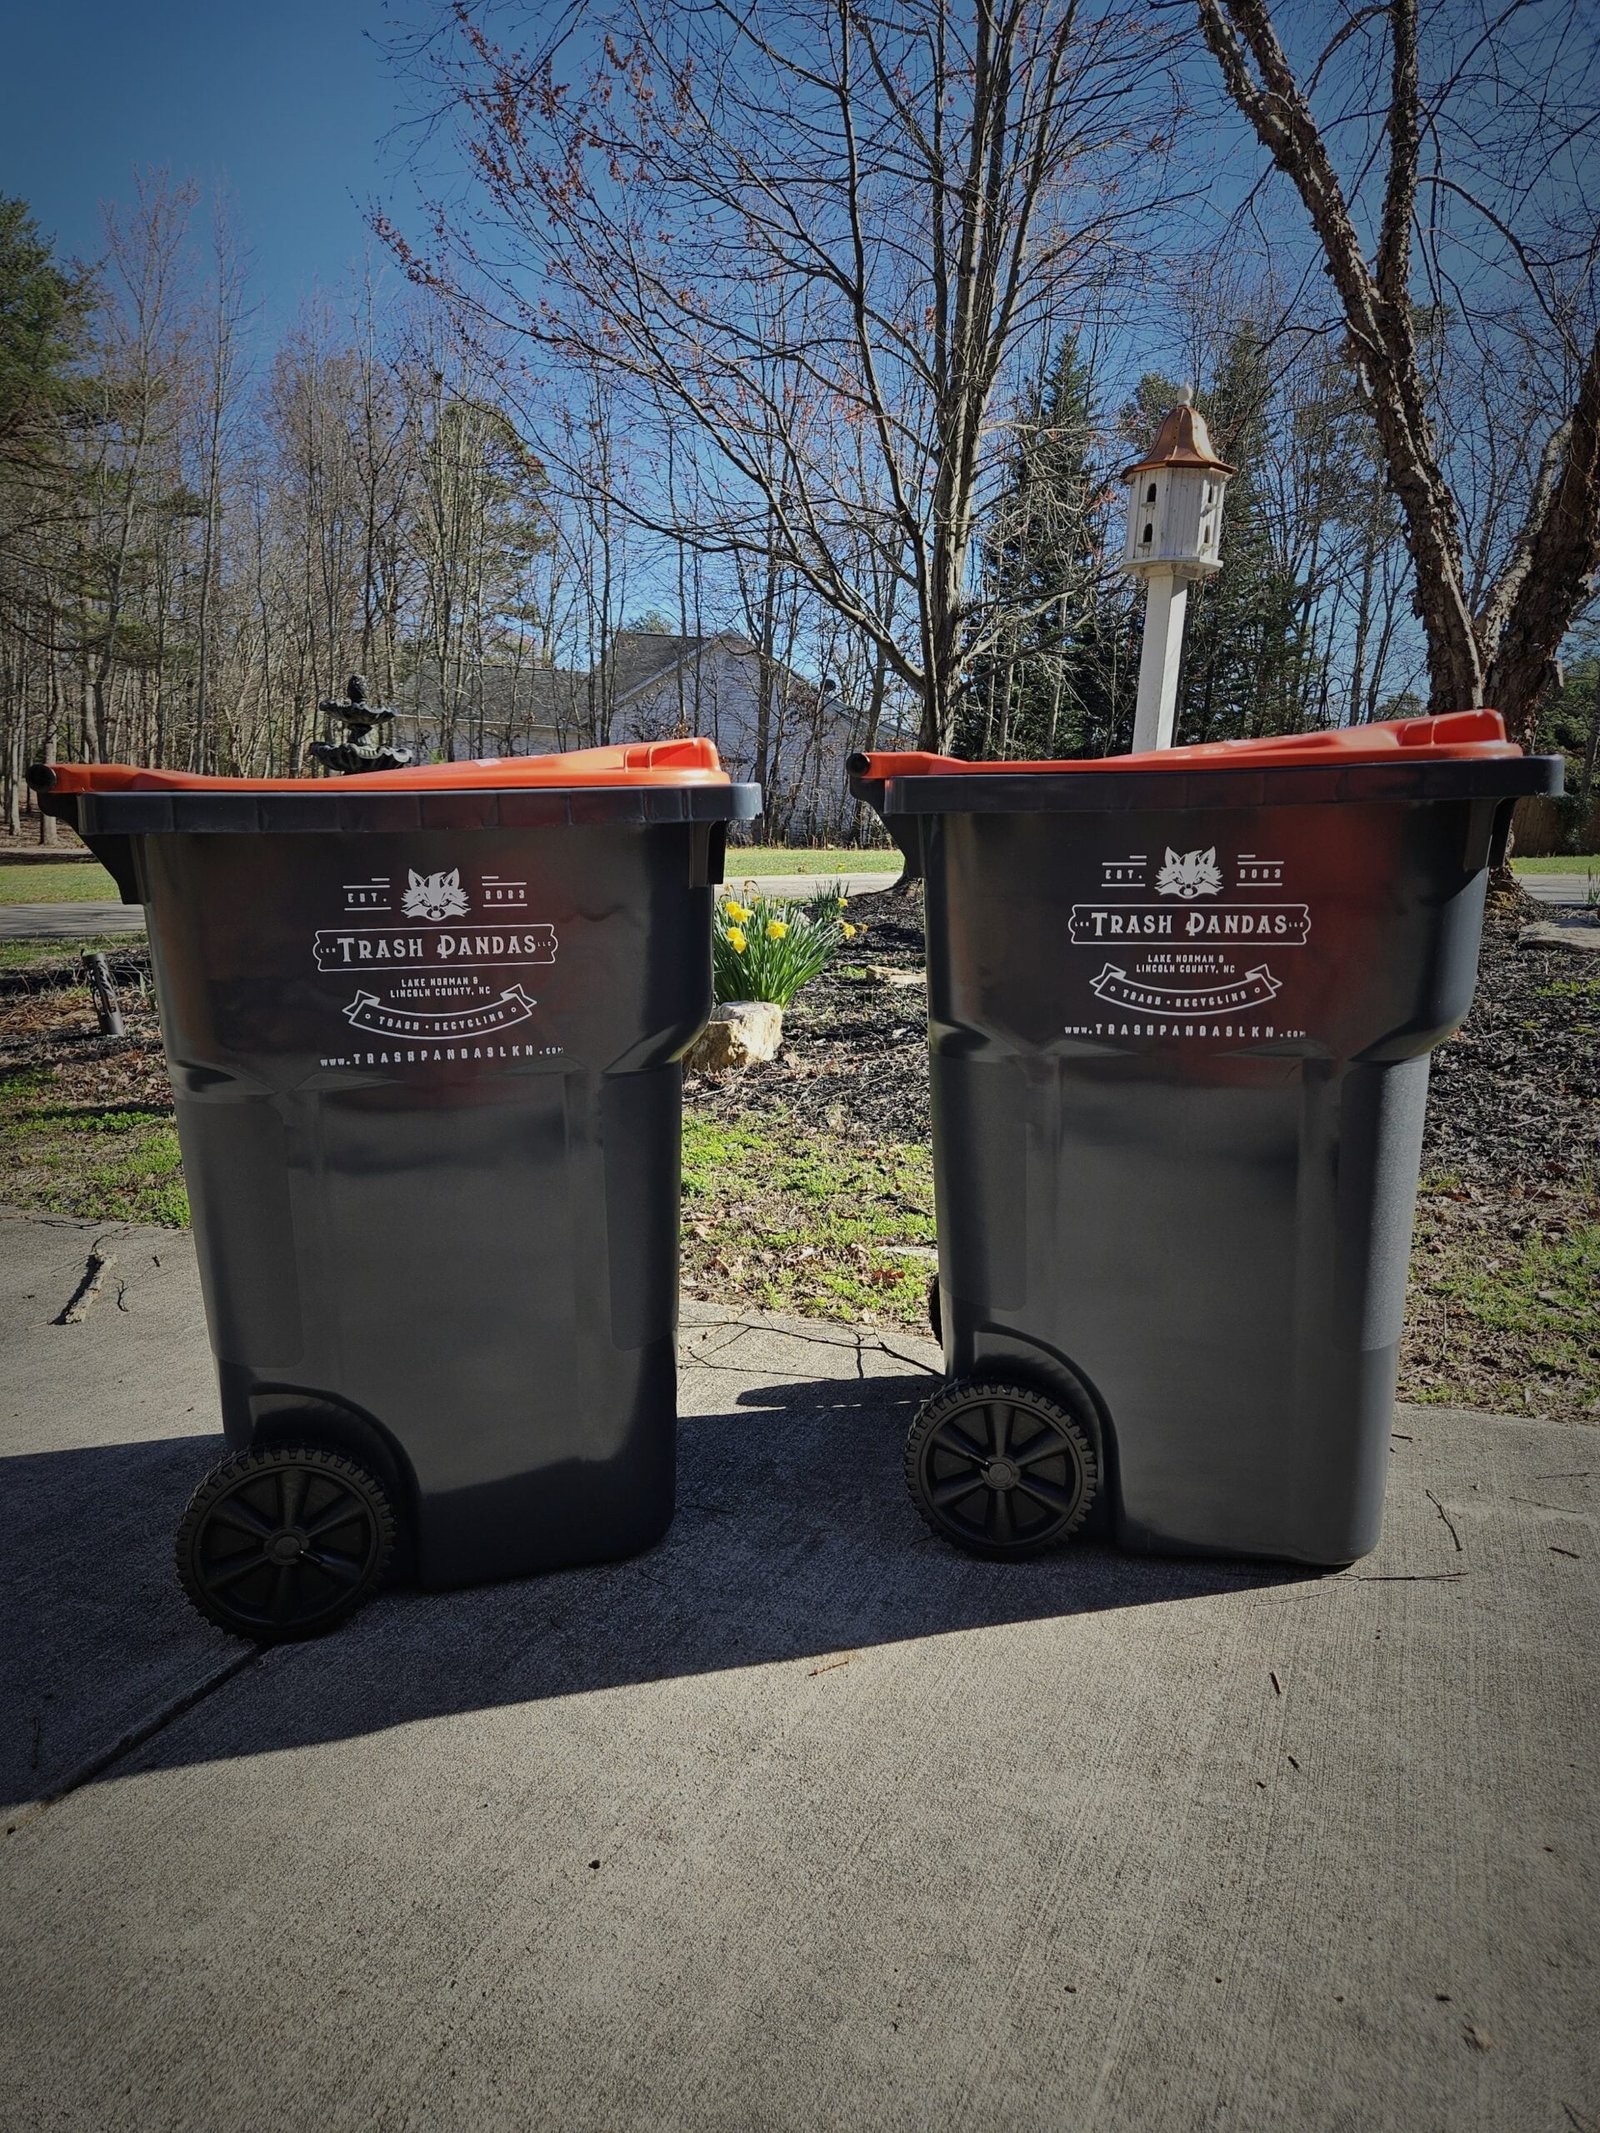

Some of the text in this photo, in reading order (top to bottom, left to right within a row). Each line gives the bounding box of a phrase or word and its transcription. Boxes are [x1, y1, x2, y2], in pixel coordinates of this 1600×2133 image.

[1091, 912, 1173, 937] TRASH
[1185, 912, 1288, 937] PANDAS
[336, 937, 424, 963] TRASH
[436, 934, 537, 959] PANDAS
[1147, 954, 1172, 963] LAKE
[1176, 954, 1214, 963] NORMAN
[1135, 963, 1236, 974] LINCOLN COUNTY, NC
[401, 978, 426, 988] LAKE
[430, 977, 469, 987] NORMAN
[390, 986, 491, 998] LINCOLN COUNTY, NC
[1122, 988, 1247, 1008] TRASH RECYCLING
[378, 1010, 505, 1032] TRASH RECYCLING
